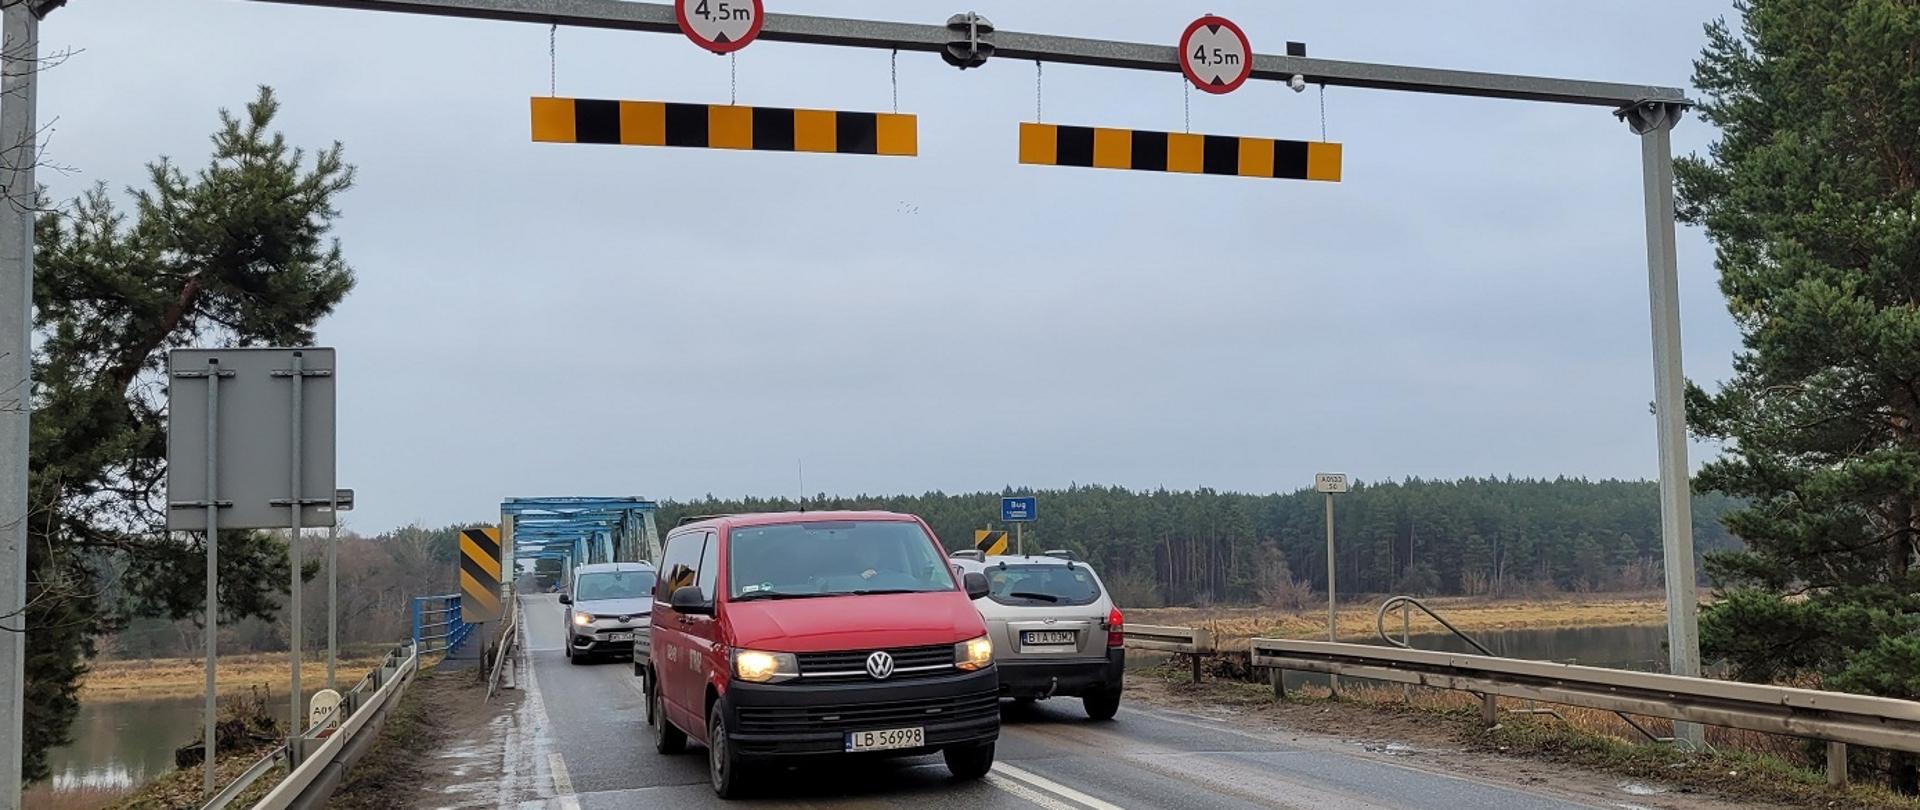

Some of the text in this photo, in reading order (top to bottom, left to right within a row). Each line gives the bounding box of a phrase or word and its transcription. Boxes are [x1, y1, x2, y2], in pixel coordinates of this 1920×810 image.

[695, 0, 750, 21] 4,5m
[1193, 44, 1239, 67] 4,5m
[1010, 501, 1026, 510] Bug
[855, 728, 922, 747] LB 56998
